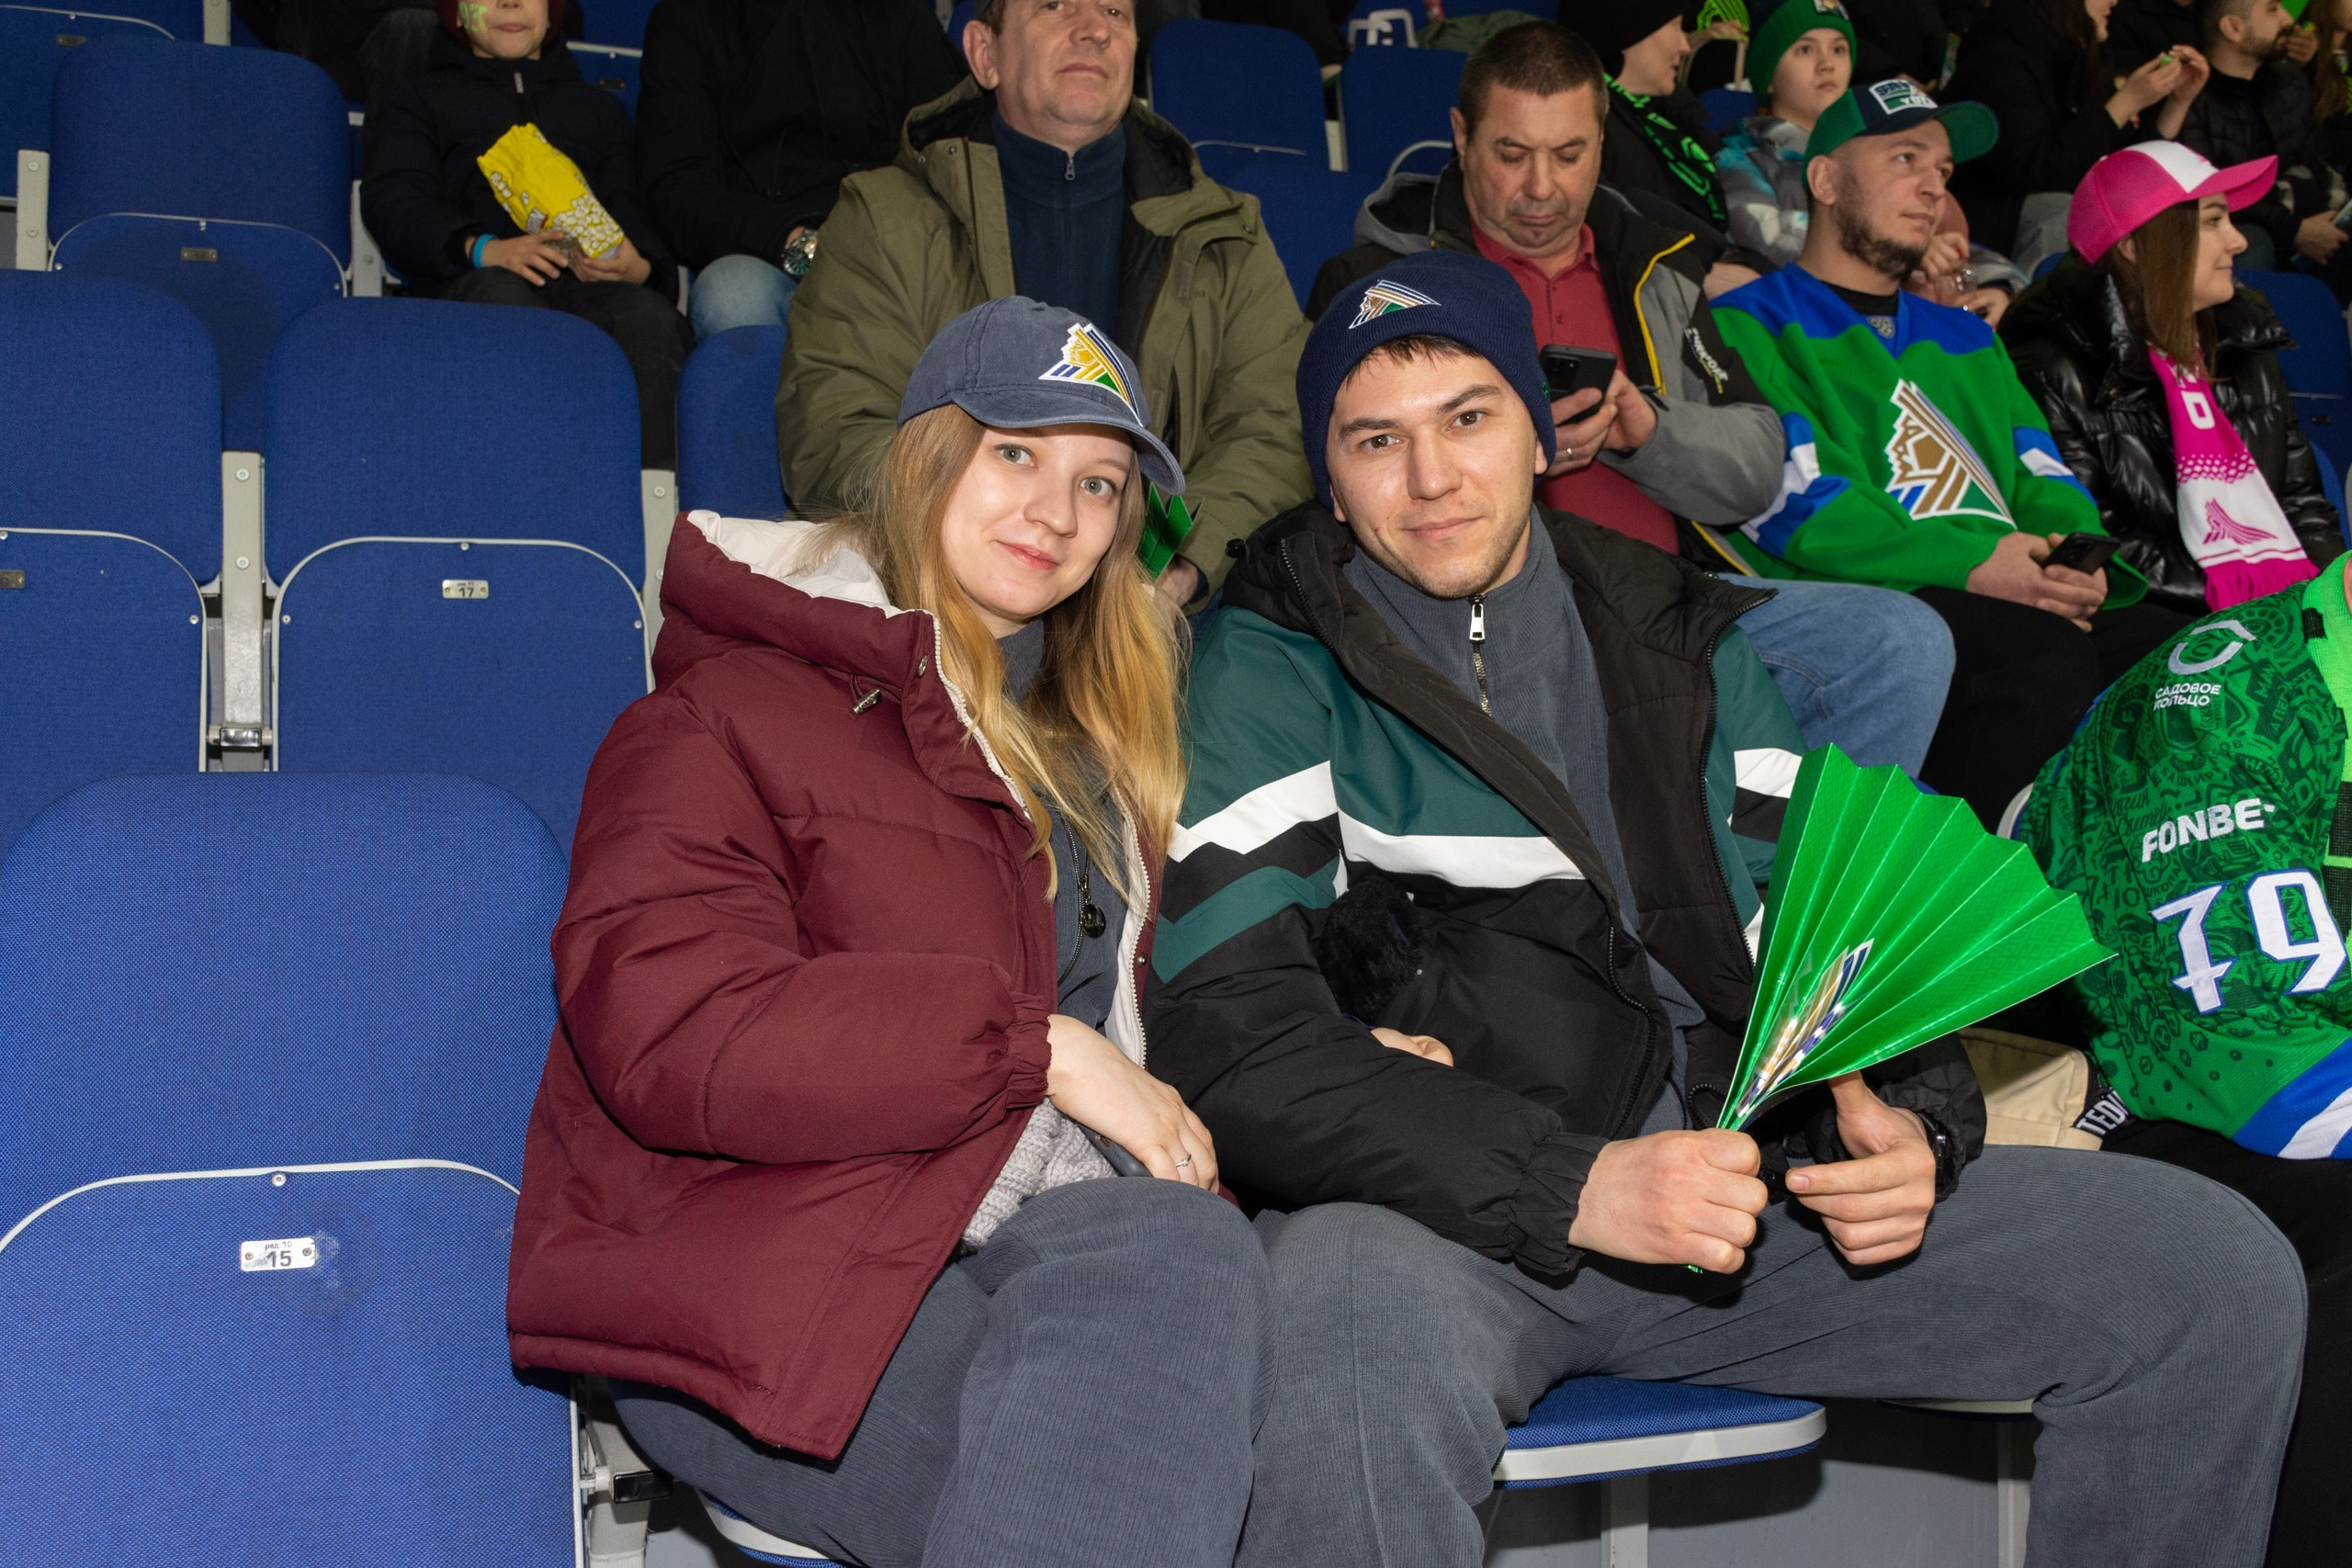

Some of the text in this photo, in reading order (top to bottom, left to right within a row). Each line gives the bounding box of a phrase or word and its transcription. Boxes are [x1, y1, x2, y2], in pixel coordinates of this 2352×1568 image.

[458, 587, 474, 598] 17
[2154, 682, 2222, 700] САДОВОЕ
[2142, 796, 2276, 863] FONBE
[2149, 867, 2348, 1017] 79
[282, 1240, 292, 1248] 10
[266, 1249, 292, 1268] 15
